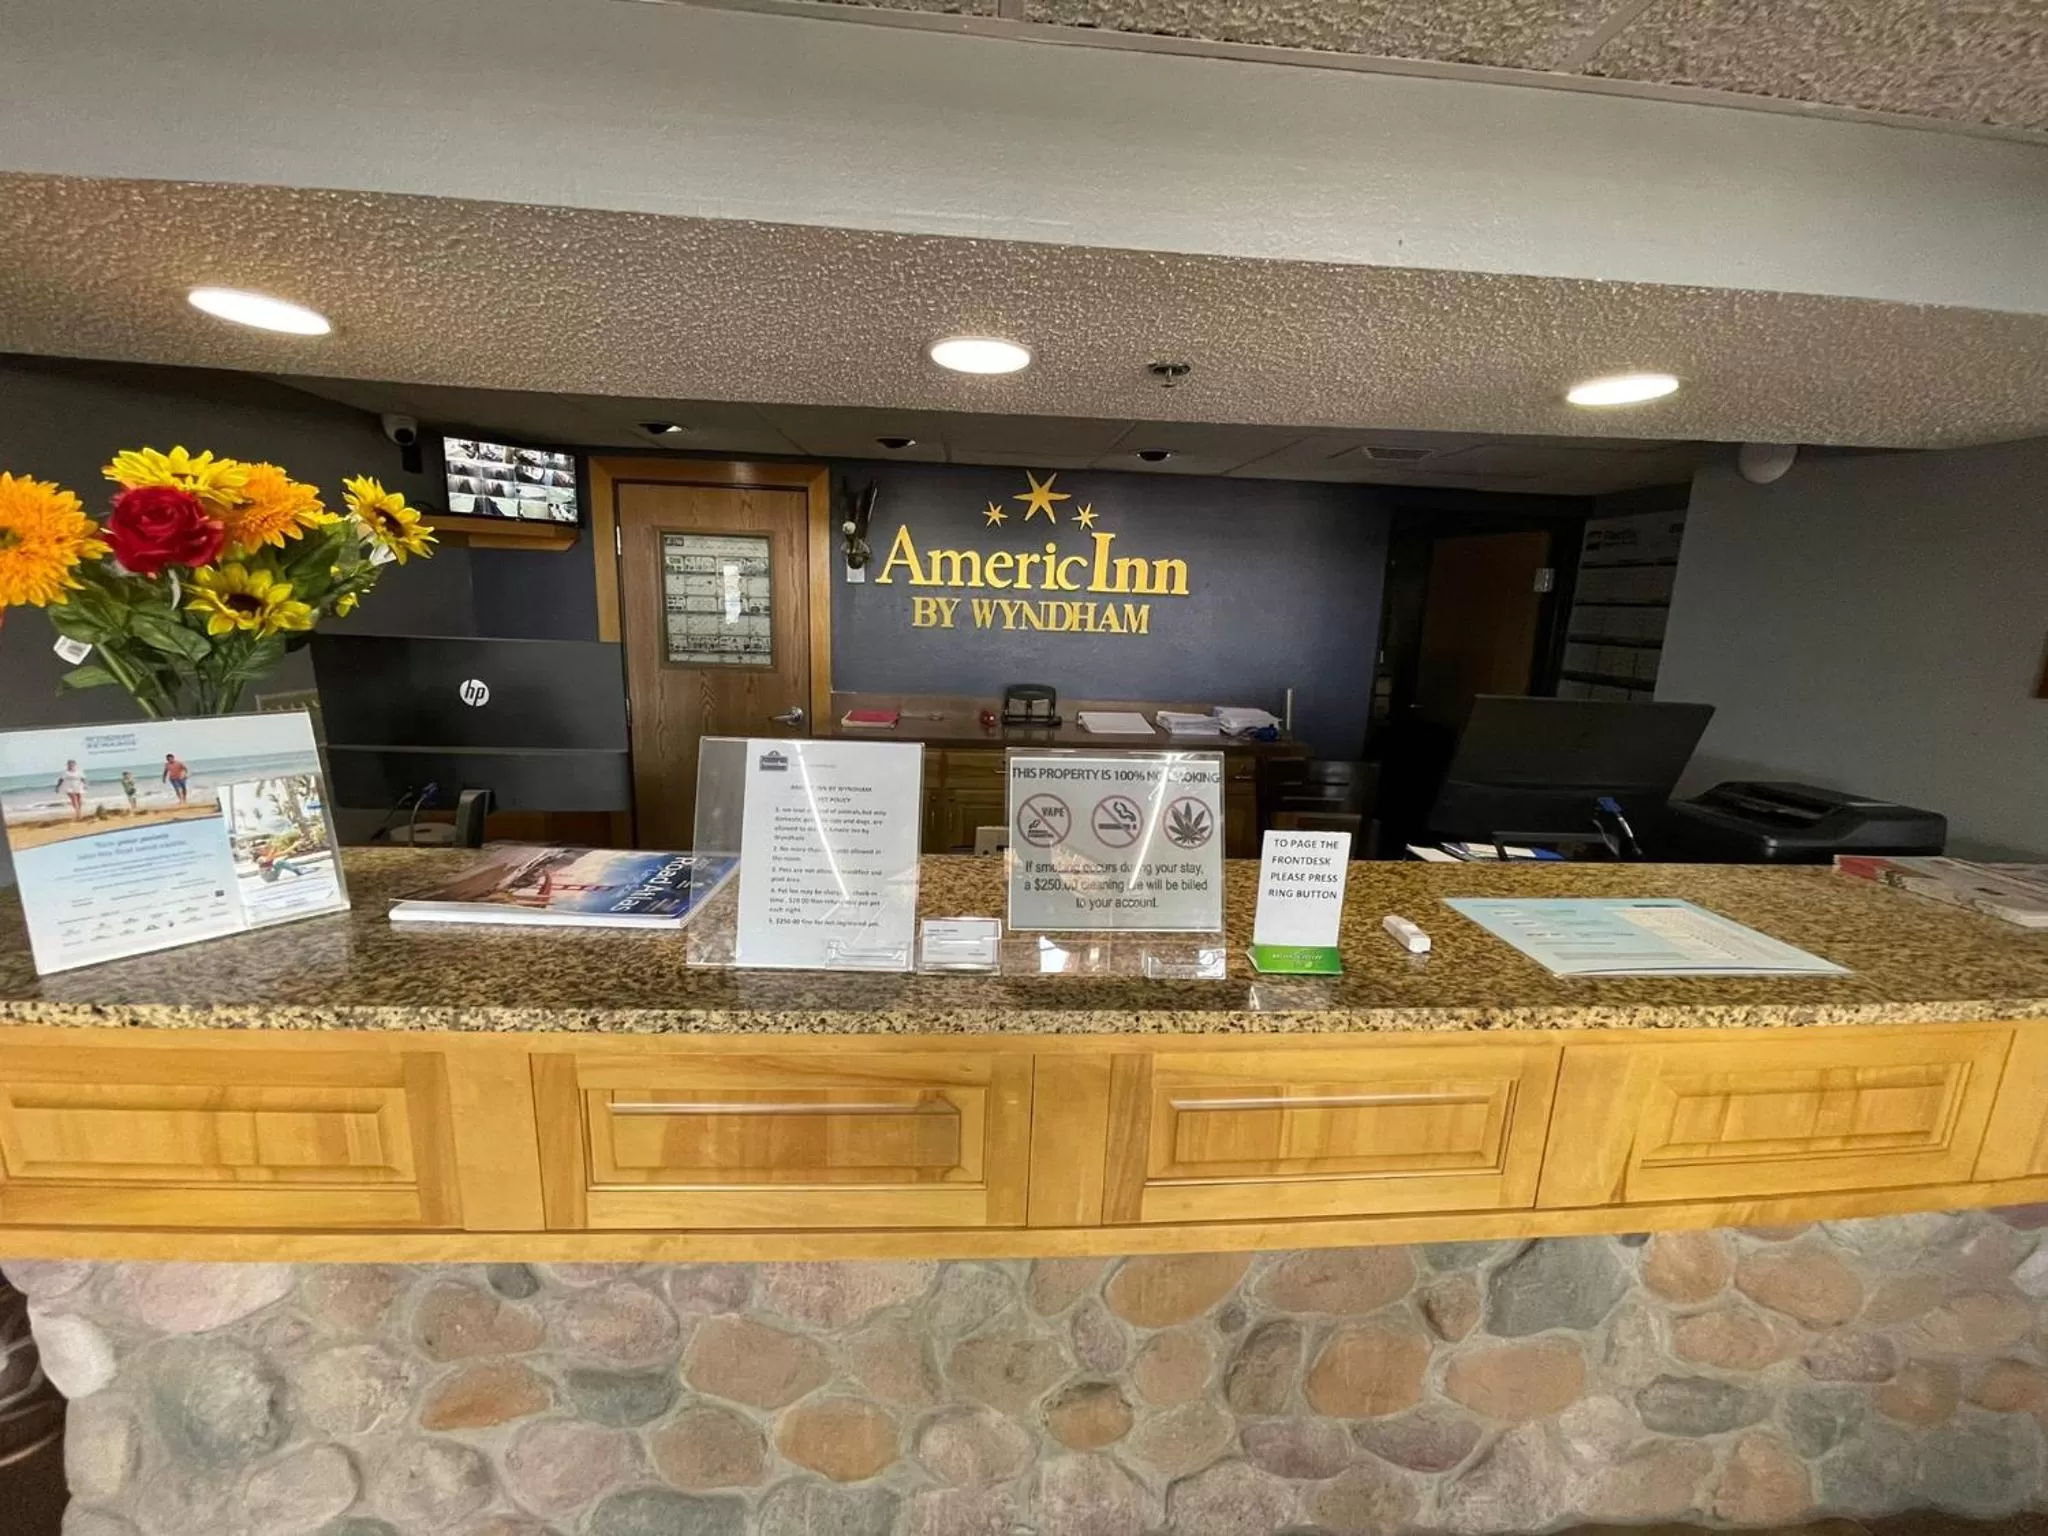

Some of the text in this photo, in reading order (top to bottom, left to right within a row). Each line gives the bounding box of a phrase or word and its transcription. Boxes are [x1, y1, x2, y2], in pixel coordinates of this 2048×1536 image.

[875, 523, 1190, 595] AmericInn
[911, 596, 1150, 635] BY WYNDHAM
[461, 679, 488, 707] hp
[1012, 767, 1036, 779] THIS
[1039, 768, 1099, 780] PROPERTY
[1101, 769, 1112, 780] IS
[1114, 769, 1145, 782] 100%
[1167, 771, 1221, 784] OKING
[1041, 806, 1066, 818] VAPE
[1274, 838, 1340, 849] TO PAGE THE
[1272, 855, 1331, 866] FRONTDESK
[648, 856, 698, 885] Road
[1025, 860, 1033, 873] If
[1120, 861, 1152, 876] dung
[1155, 863, 1177, 877] your
[1270, 871, 1339, 883] PLEASE PRESS
[1024, 881, 1032, 891] a
[1146, 879, 1162, 891] will
[1165, 879, 1179, 891] be
[1181, 879, 1208, 892] billed
[1268, 888, 1338, 900] RING BUTTON
[1075, 897, 1087, 908] to
[1089, 898, 1112, 911] your
